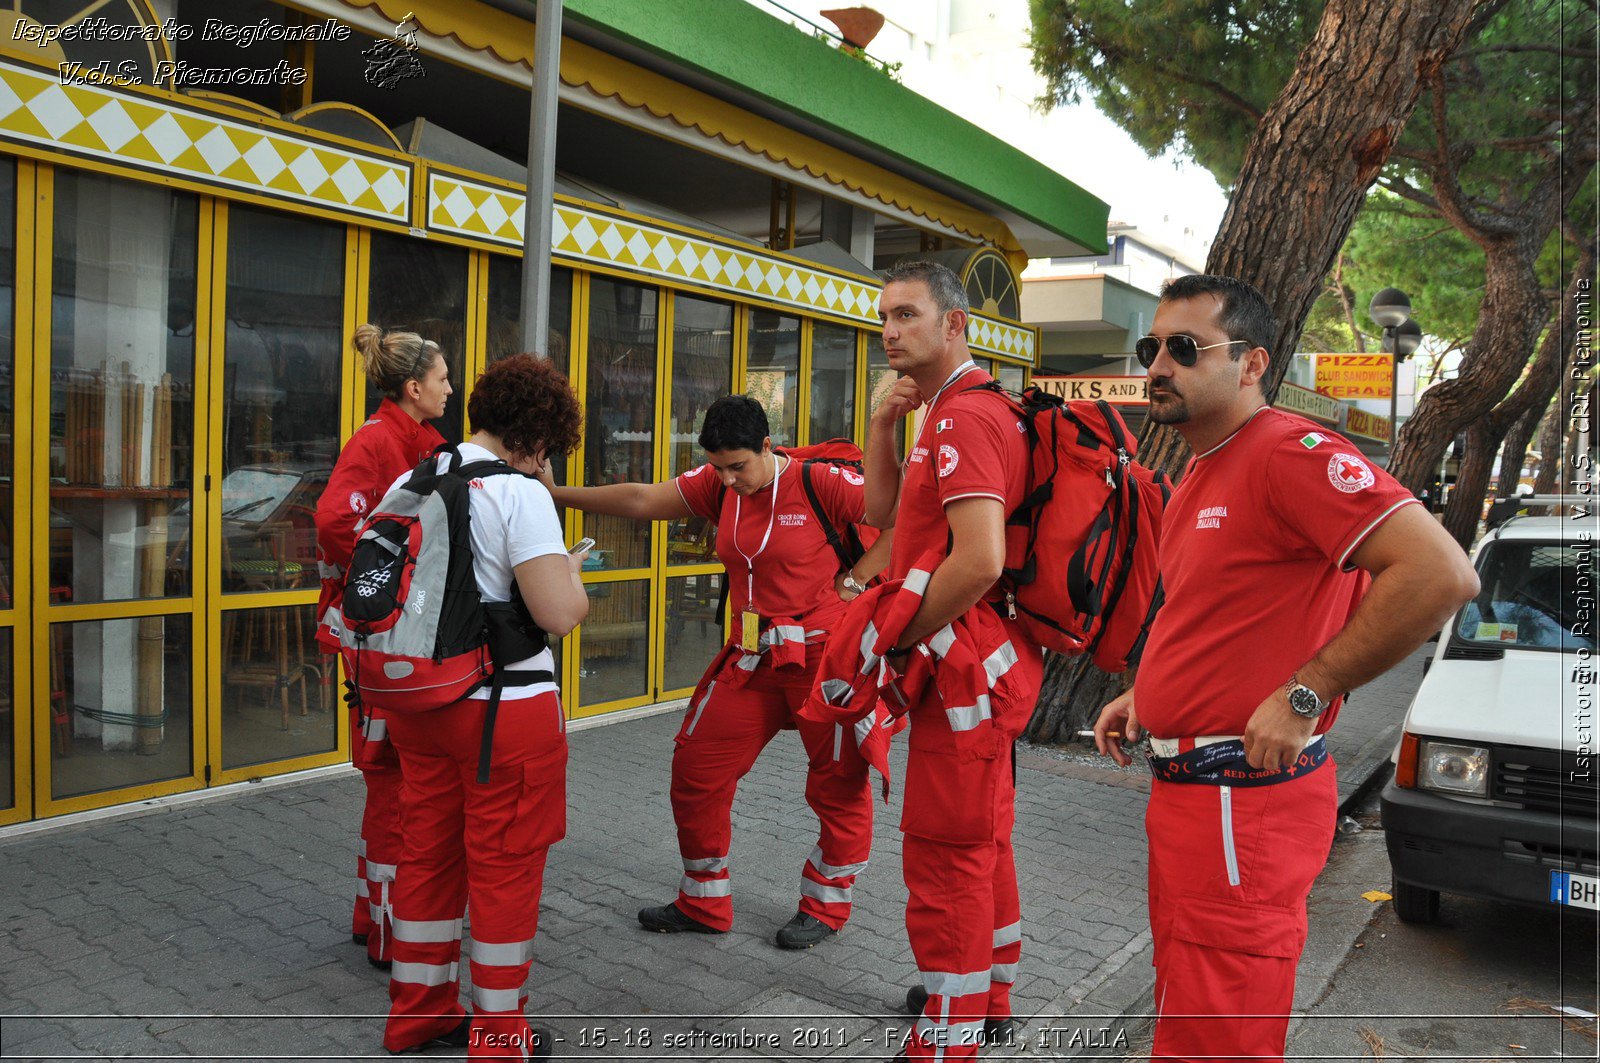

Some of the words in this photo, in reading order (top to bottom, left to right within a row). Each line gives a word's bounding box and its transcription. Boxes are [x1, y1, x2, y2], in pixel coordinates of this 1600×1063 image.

[1317, 356, 1392, 367] PIZZA
[1317, 370, 1340, 382] CLUB
[1343, 370, 1393, 382] SANDWICH
[1108, 384, 1137, 396] AND
[1316, 386, 1392, 397] KEBAB
[1281, 385, 1306, 410] DRINKS
[1315, 396, 1332, 417] FRUIT
[1346, 407, 1368, 435] PIZZA
[1223, 769, 1247, 779] RED
[1248, 767, 1282, 779] CROSS
